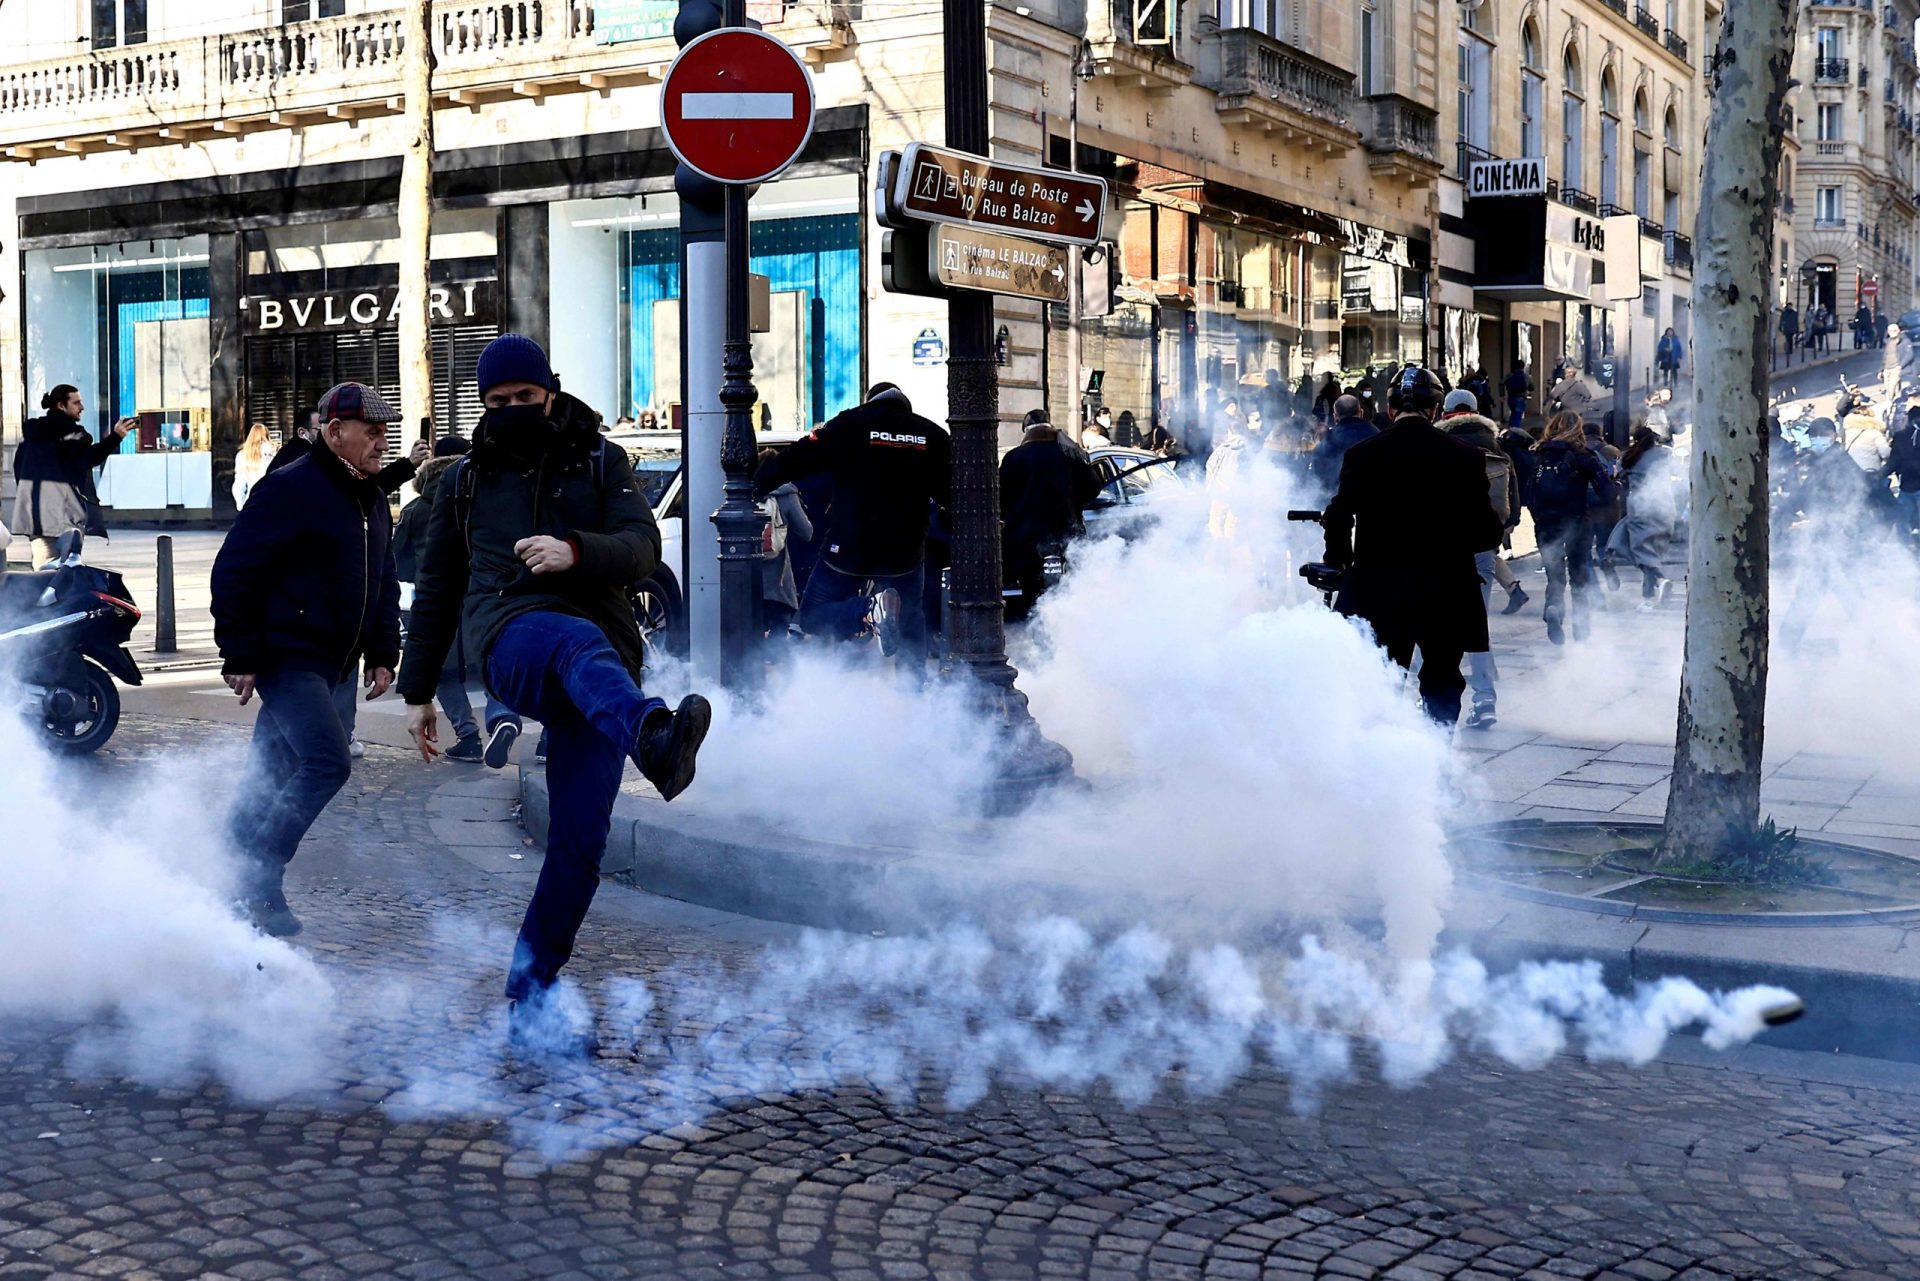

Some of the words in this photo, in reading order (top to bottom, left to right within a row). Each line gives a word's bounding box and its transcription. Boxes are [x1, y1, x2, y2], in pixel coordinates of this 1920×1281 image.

[962, 169, 1003, 193] Bureau
[1010, 179, 1025, 197] de
[1031, 182, 1069, 204] Poste
[1473, 161, 1540, 192] CINÉMA
[961, 194, 976, 214] 10,
[982, 198, 1007, 217] Rue
[1012, 203, 1056, 226] Balzac
[962, 242, 995, 260] cinéma
[999, 247, 1009, 261] LE
[1013, 250, 1047, 268] BALZAC
[970, 265, 982, 275] rue
[985, 265, 1010, 280] Balzac
[870, 431, 926, 445] POLARIS
